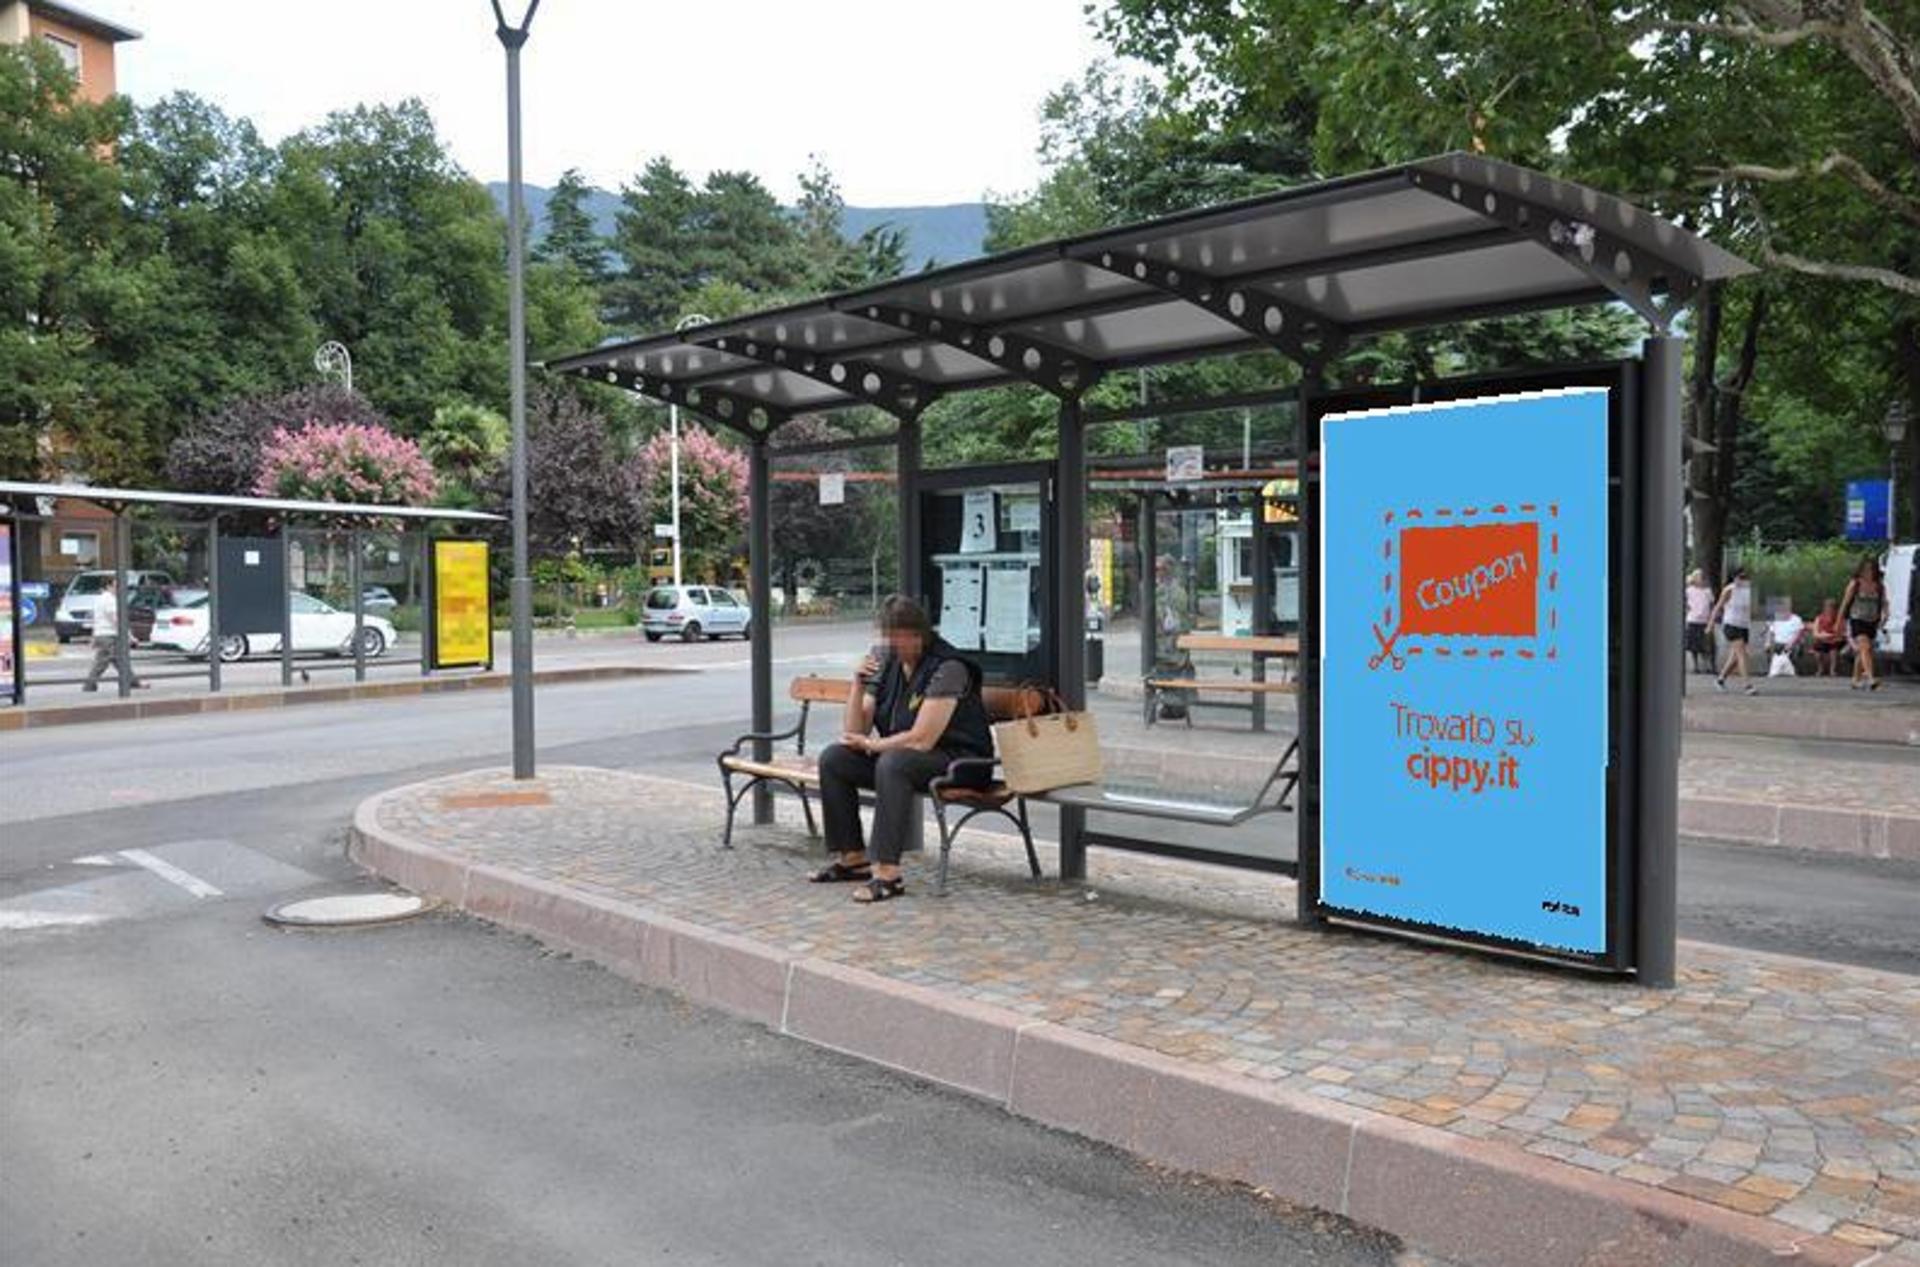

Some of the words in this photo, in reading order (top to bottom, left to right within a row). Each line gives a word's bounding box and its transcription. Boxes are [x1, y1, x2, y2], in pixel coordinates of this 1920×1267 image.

[973, 512, 985, 538] 3
[1415, 551, 1527, 611] Coupon
[1390, 701, 1496, 745] Trovato
[1505, 718, 1535, 747] su
[1406, 746, 1520, 793] cippy.it
